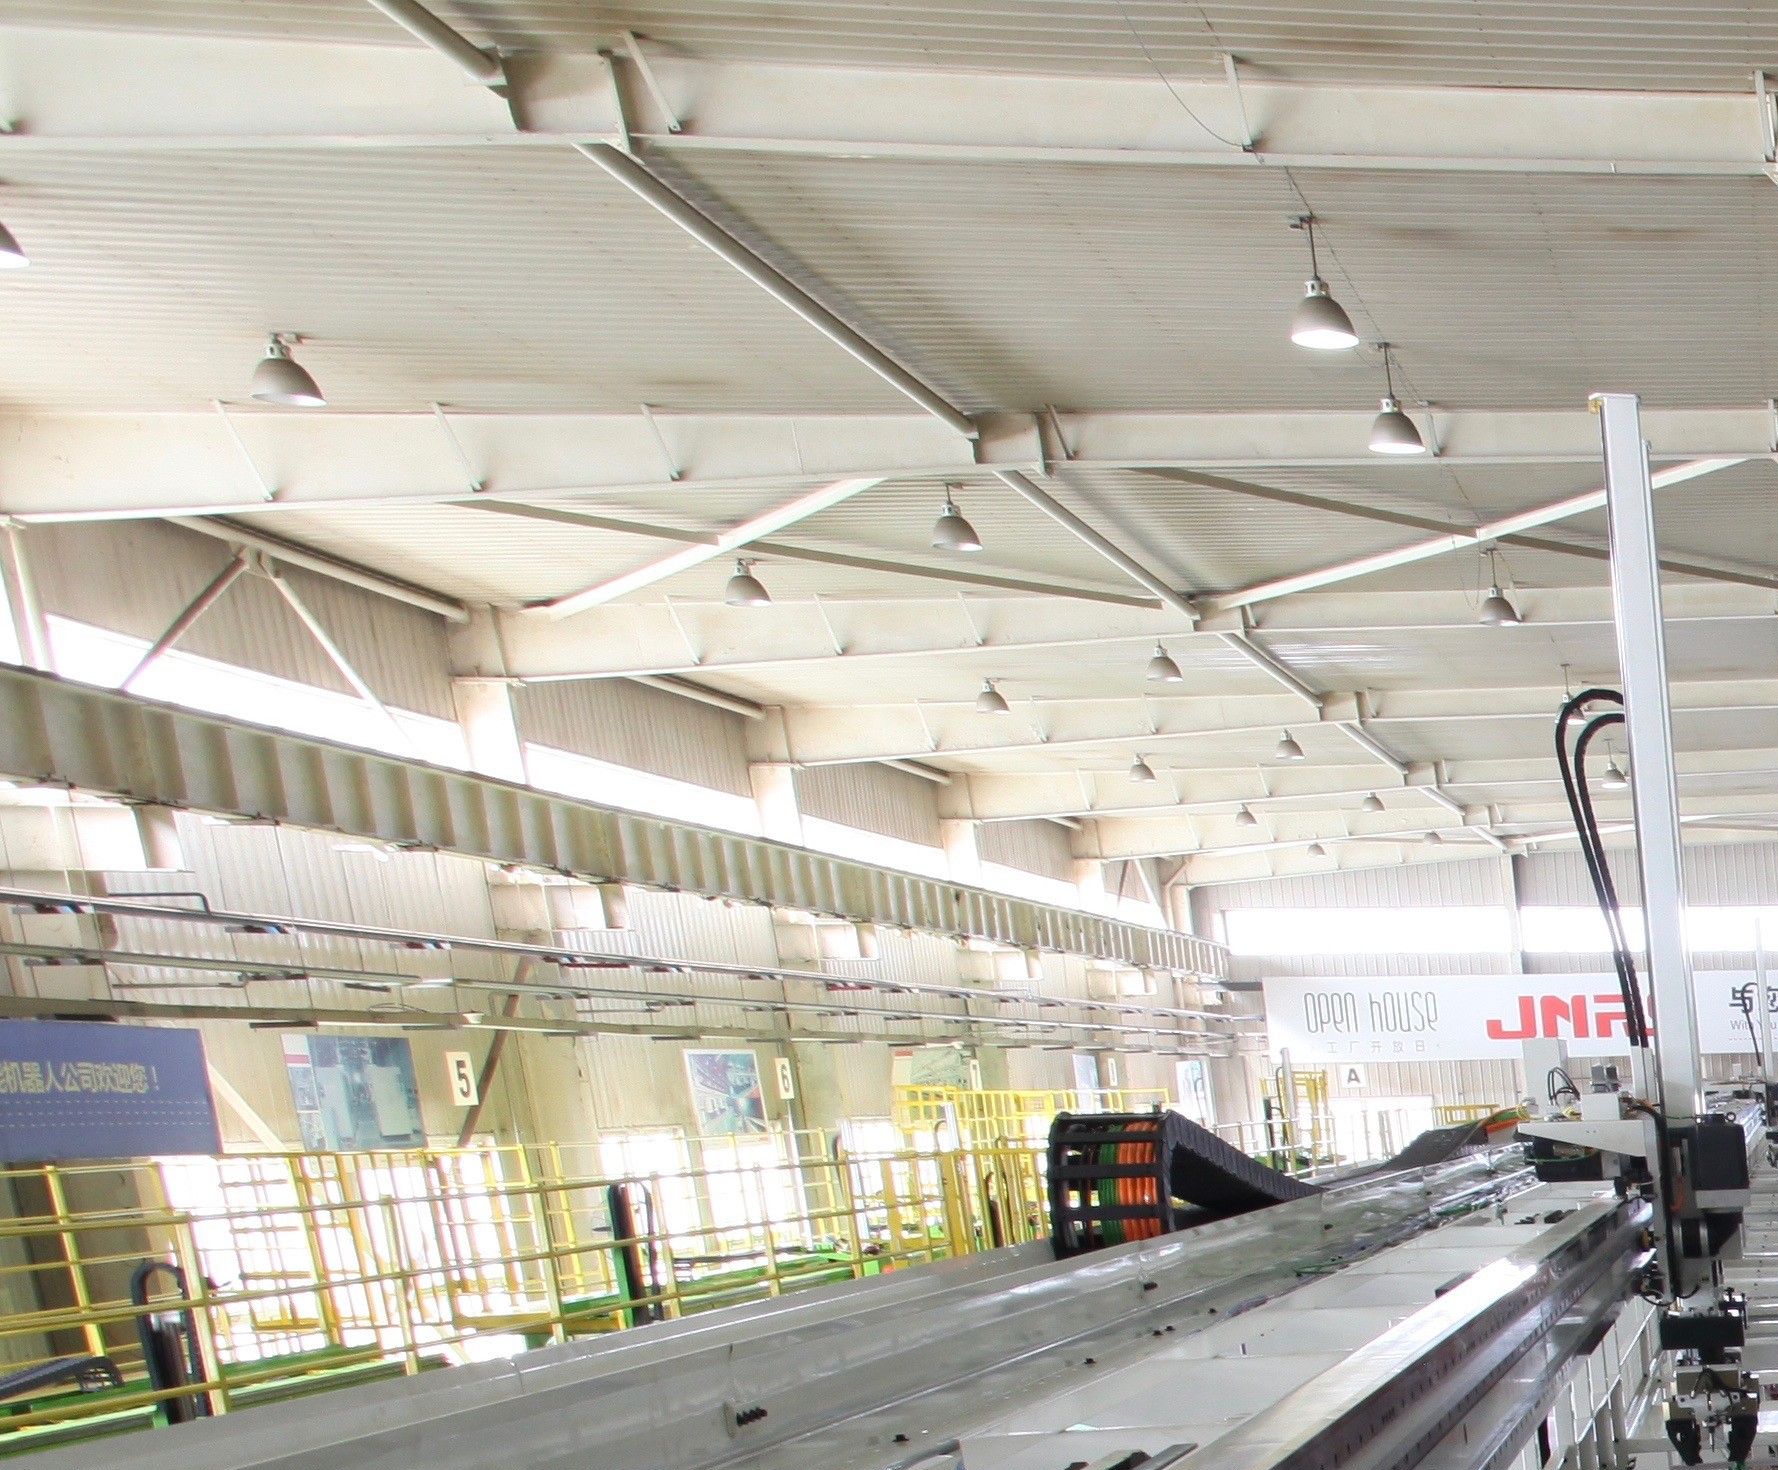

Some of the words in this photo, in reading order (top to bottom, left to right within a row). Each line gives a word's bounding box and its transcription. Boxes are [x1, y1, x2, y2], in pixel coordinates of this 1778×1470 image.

[1755, 1019, 1777, 1030] Yu
[1327, 1040, 1427, 1054] 工厂开放日
[0, 1061, 160, 1094] 机器人公司欢迎您！
[456, 1060, 471, 1098] 5
[780, 1064, 790, 1092] 6
[1347, 1068, 1360, 1084] A
